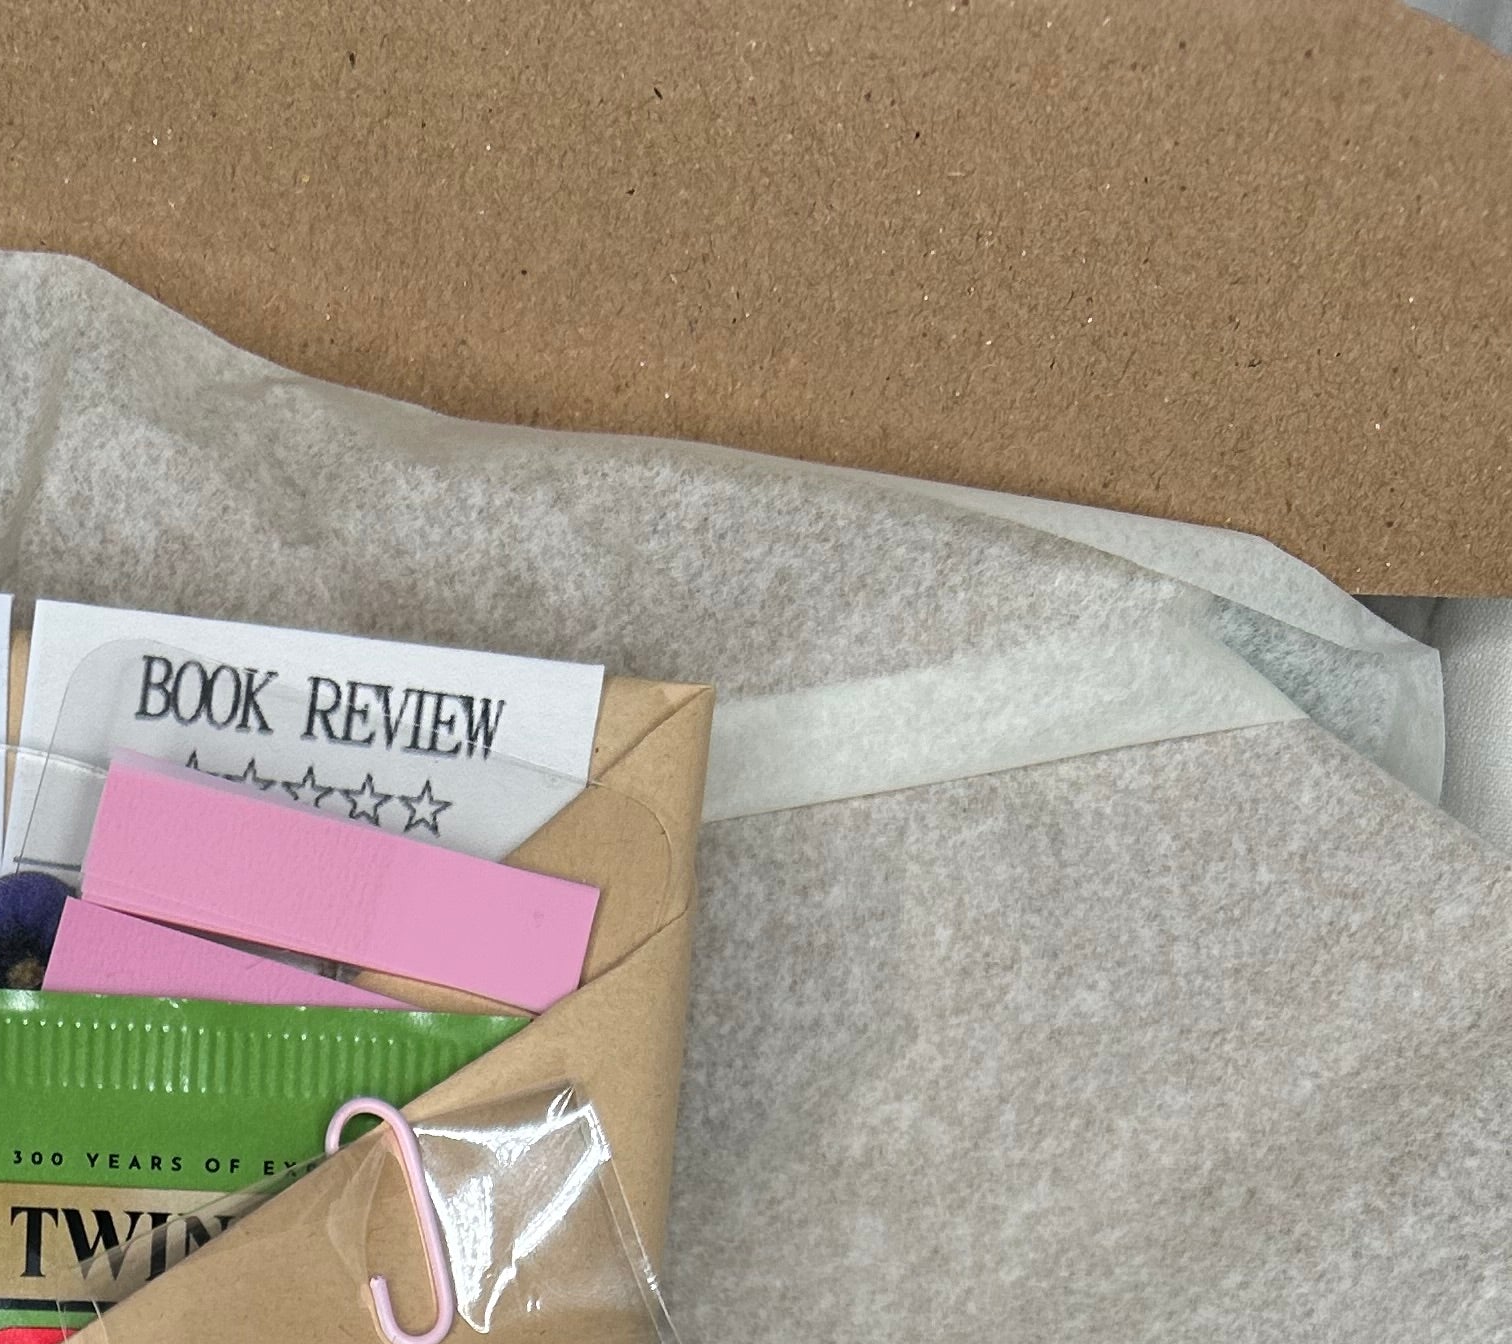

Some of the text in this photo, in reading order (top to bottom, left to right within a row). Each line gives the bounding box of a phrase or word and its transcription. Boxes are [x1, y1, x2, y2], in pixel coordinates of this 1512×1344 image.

[135, 655, 507, 762] BOOK REVIEW
[12, 1149, 65, 1167] 300
[86, 1152, 183, 1173] YEARS
[204, 1158, 241, 1175] OF
